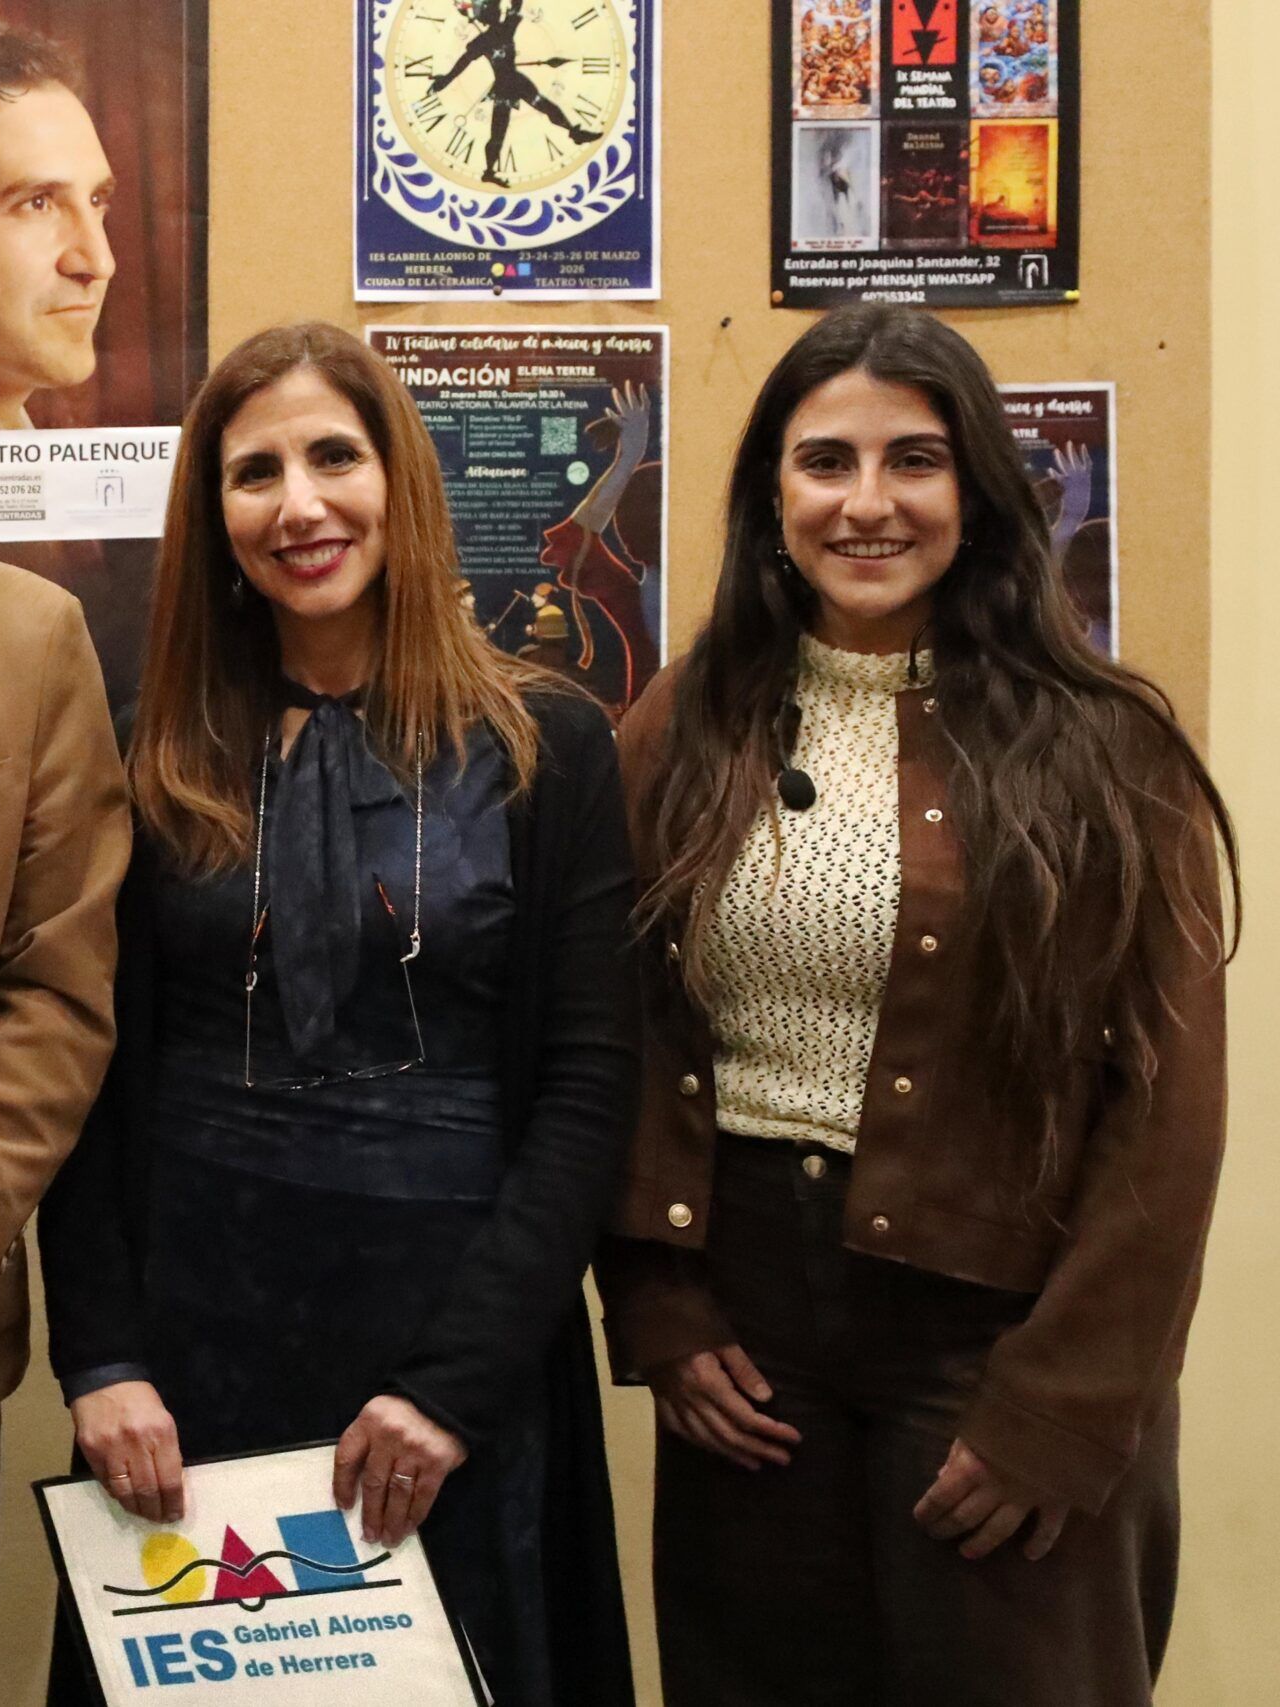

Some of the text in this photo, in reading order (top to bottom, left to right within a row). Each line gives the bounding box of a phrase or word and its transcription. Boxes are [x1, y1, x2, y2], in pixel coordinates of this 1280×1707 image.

[916, 97, 957, 108] TEATRO
[369, 252, 492, 261] IES GABRIEL ALONSO DE
[584, 251, 598, 260] DE
[601, 251, 640, 260] MARZO
[784, 257, 840, 270] Entradas
[841, 259, 857, 269] en
[916, 255, 983, 269] Santander,
[985, 256, 1000, 268] 32
[405, 265, 454, 274] HERRERA
[559, 264, 585, 274] 2026
[364, 276, 494, 287] CIUDAD DE LA CERÁMICA
[535, 277, 630, 287] TEATRO VICTORIA
[789, 273, 996, 289] Reservas por MENSAJE WHATSAPP
[523, 335, 539, 349] de
[393, 362, 511, 387] UNDACIÓN
[517, 365, 596, 376] ELENA TERTRE
[501, 389, 538, 401] Domingo
[494, 400, 537, 409] TALAVERA
[539, 400, 550, 409] DE
[551, 400, 563, 409] LA
[564, 400, 589, 409] REINA
[49, 441, 170, 463] PALENQUE
[11, 485, 26, 494] 076
[27, 484, 42, 494] 262
[121, 1613, 413, 1688] IES Gabriel Alonso
[244, 1651, 378, 1678] de Herrera
